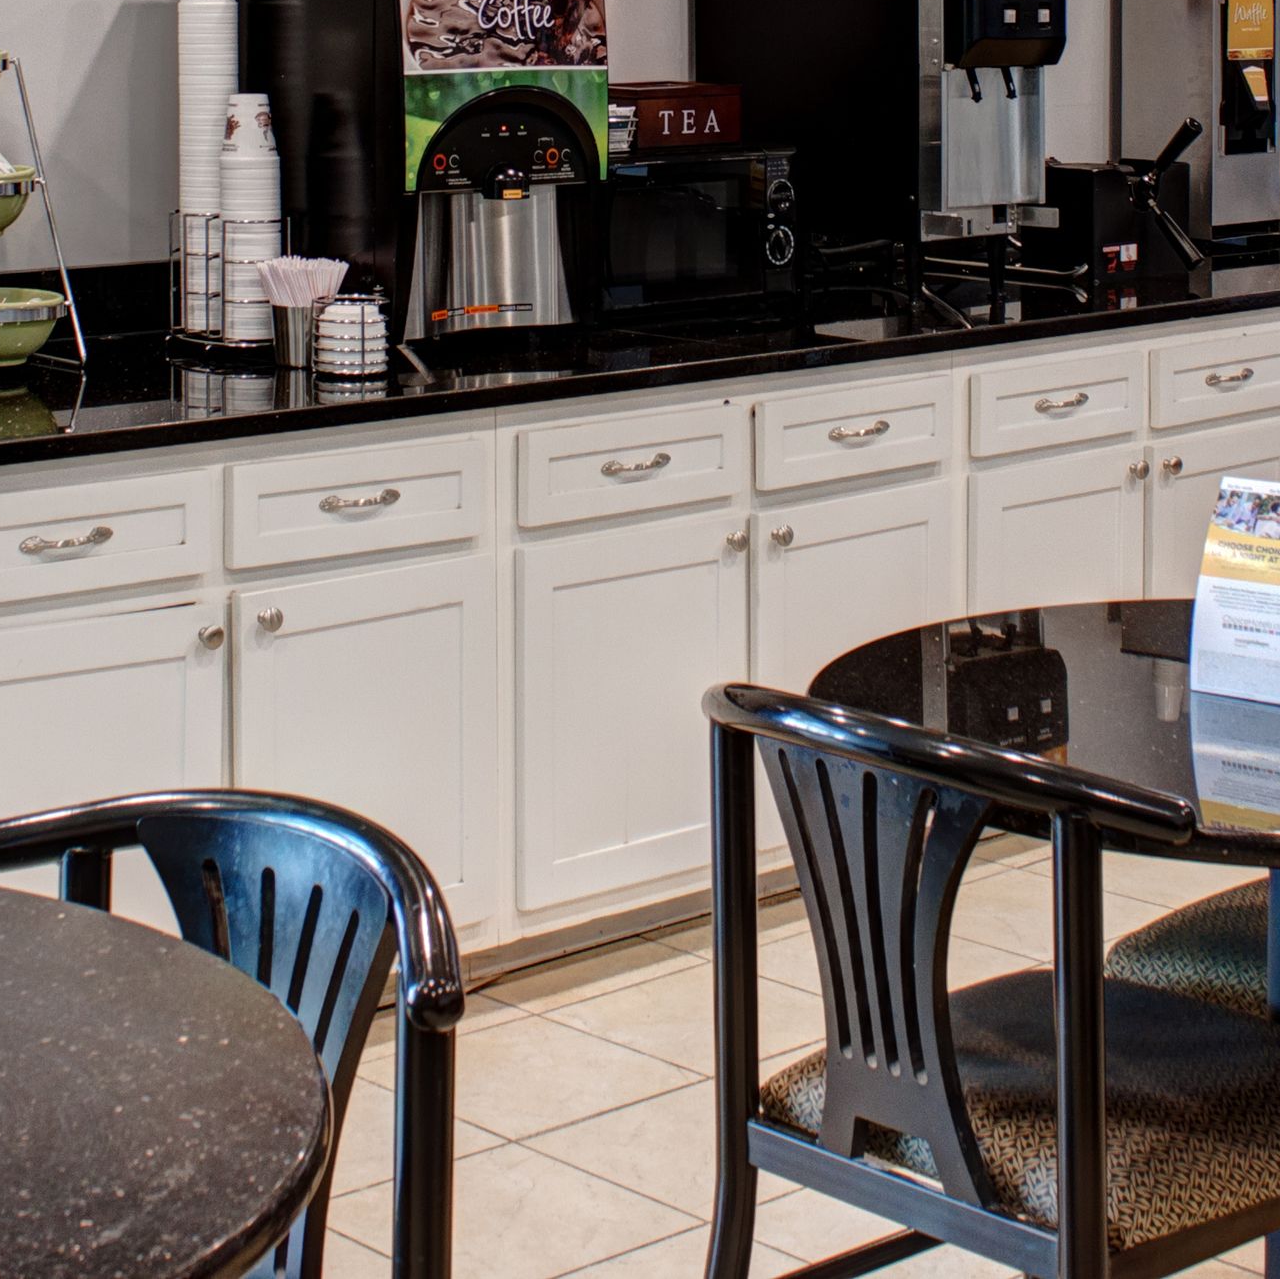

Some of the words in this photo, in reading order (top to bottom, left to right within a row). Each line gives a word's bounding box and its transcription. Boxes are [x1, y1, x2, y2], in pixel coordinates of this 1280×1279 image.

[1234, 1, 1268, 26] Waffle
[658, 108, 721, 135] TEA
[1217, 540, 1254, 553] CHOOSE
[1267, 556, 1279, 565] AT
